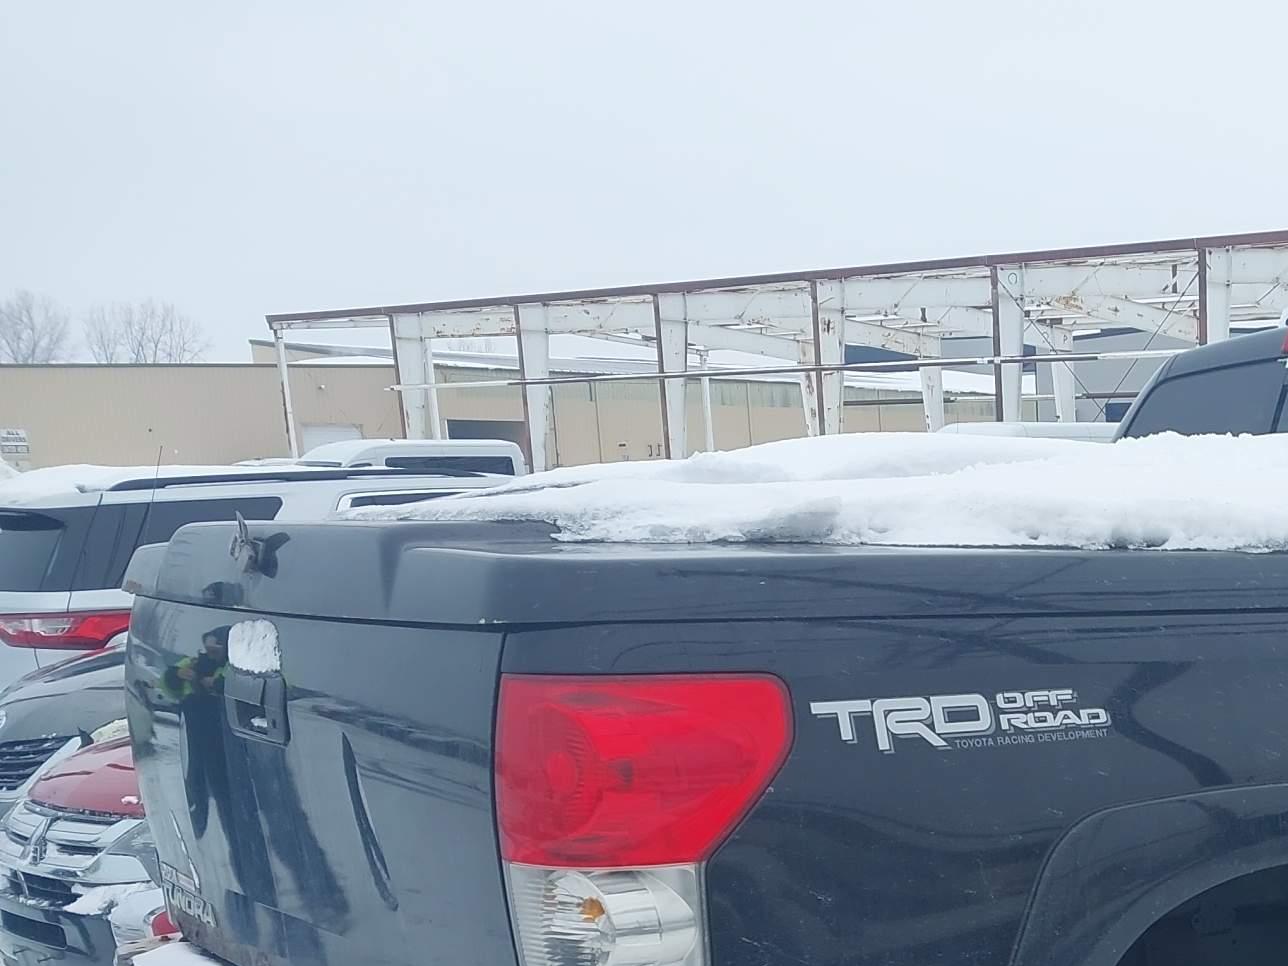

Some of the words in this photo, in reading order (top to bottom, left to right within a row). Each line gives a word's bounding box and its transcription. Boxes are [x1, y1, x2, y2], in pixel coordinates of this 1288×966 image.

[996, 689, 1078, 711] OFF
[809, 693, 996, 754] TRD
[999, 708, 1112, 733] ROAD
[954, 737, 995, 750] TOYOTA
[997, 733, 1036, 746] RACING
[1038, 728, 1109, 743] DEVELOPMENT
[162, 882, 218, 928] TUNDRA
